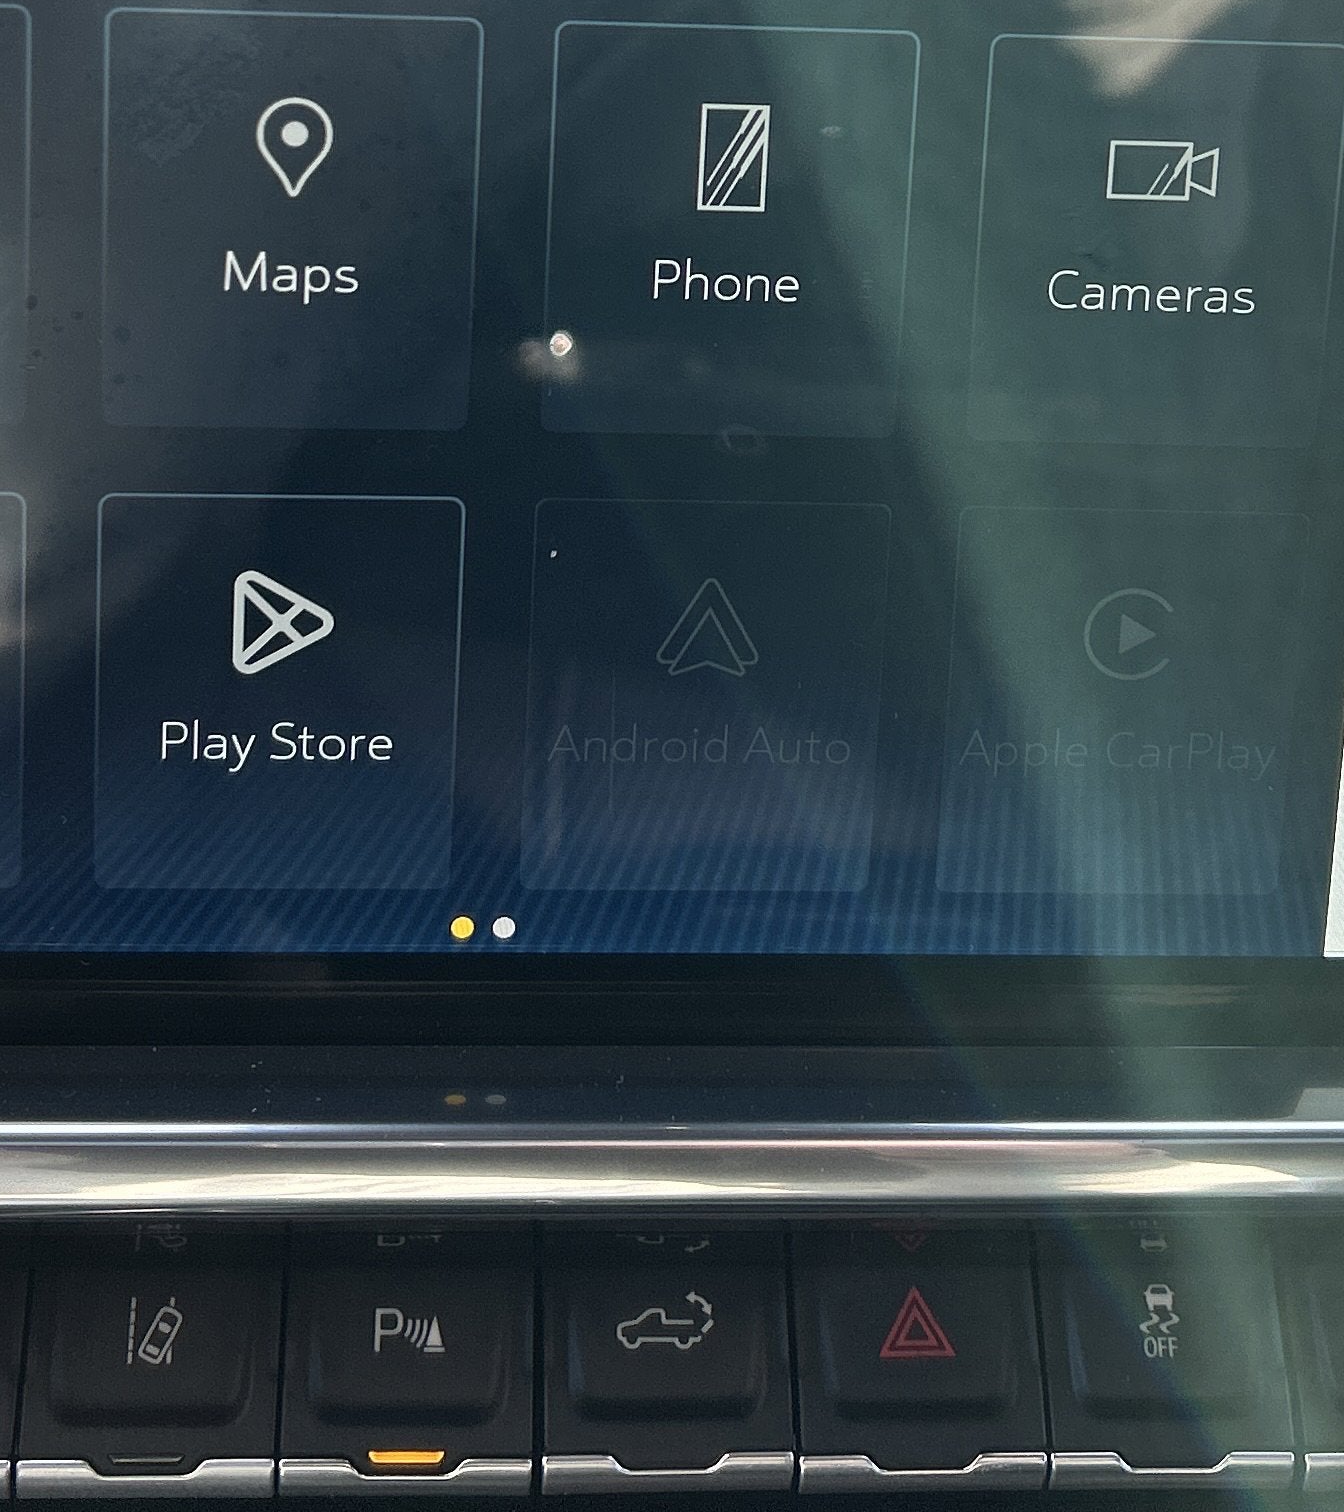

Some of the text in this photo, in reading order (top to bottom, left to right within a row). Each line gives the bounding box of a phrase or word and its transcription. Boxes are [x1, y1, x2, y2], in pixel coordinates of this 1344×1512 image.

[223, 250, 360, 305] Maps
[652, 258, 800, 304] Phone
[1047, 270, 1257, 315] Cameras
[159, 720, 393, 773] Play Store
[546, 723, 853, 766] Android Auto
[958, 728, 1278, 783] Apple CarPlay
[1142, 1336, 1179, 1358] OFF
